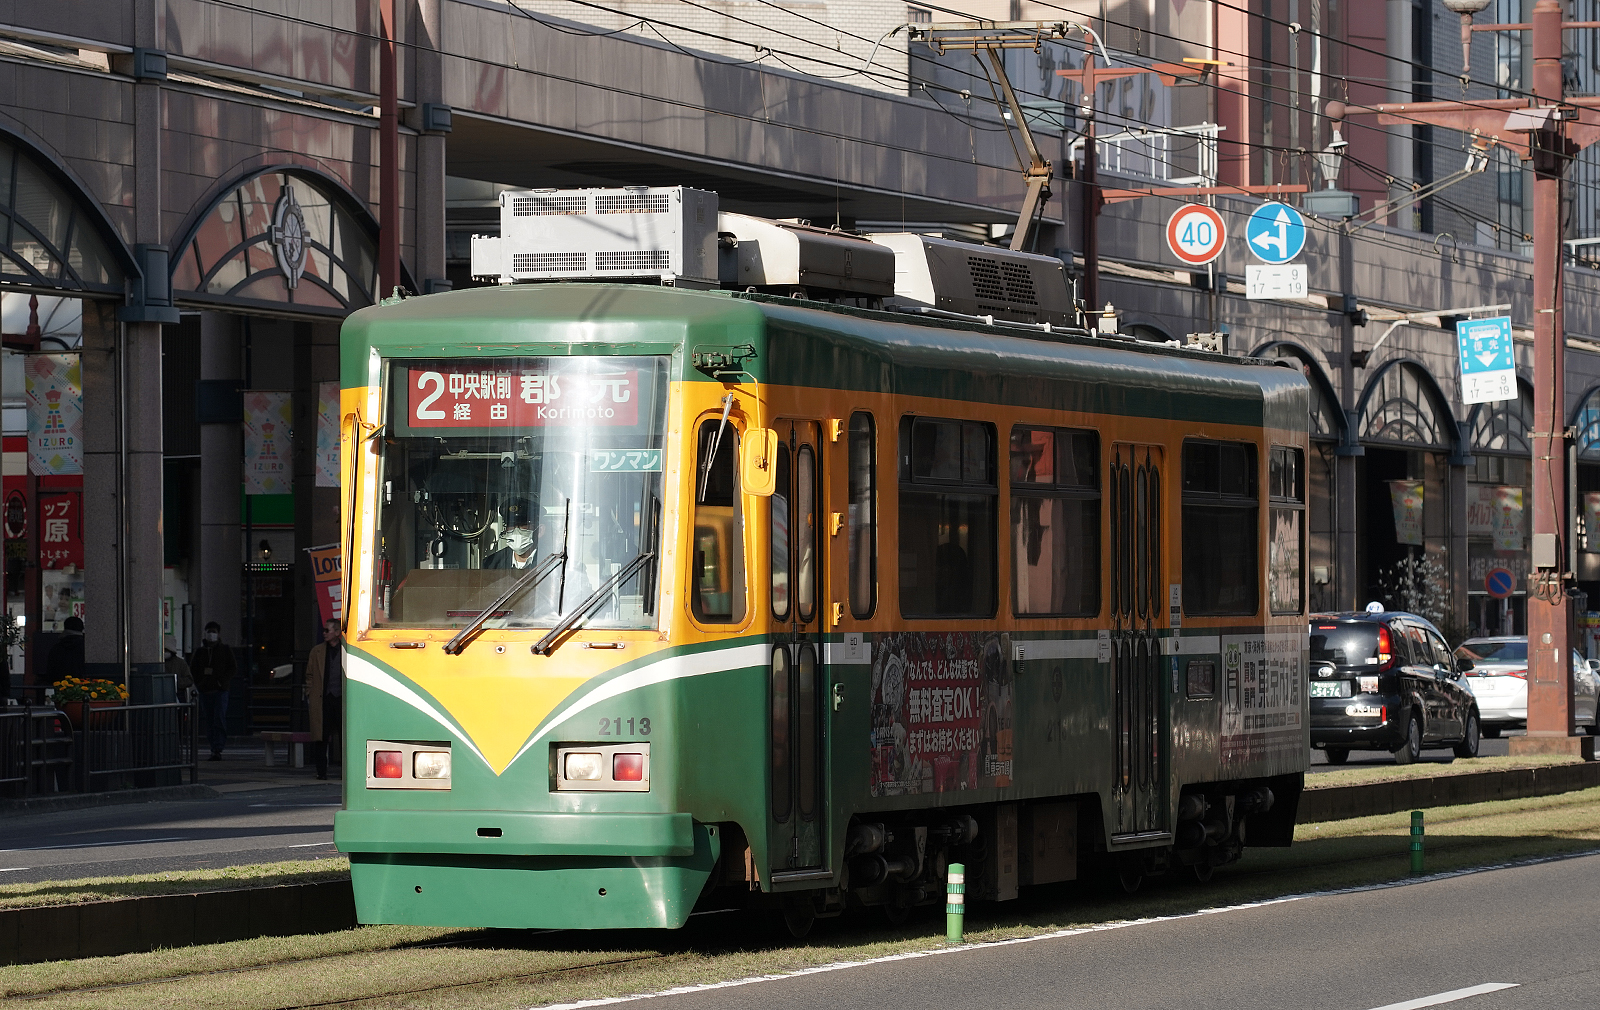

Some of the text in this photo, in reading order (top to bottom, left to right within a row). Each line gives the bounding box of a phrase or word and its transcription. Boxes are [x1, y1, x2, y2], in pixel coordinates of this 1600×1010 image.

[1182, 221, 1211, 246] 40
[1255, 269, 1262, 281] 7
[1291, 268, 1299, 281] 9
[1252, 283, 1265, 294] 17
[1288, 282, 1302, 294] 19
[1474, 339, 1499, 352] 優先
[449, 370, 511, 400] 中央駅前
[1472, 378, 1477, 388] 7
[1500, 375, 1507, 385] 9
[416, 371, 446, 420] 2
[1470, 388, 1480, 399] 17
[1499, 385, 1510, 395] 19
[453, 402, 508, 421] 経由
[537, 405, 615, 420] Korimoto
[38, 437, 74, 447] IZURO
[594, 451, 658, 469] ワンマン
[44, 518, 70, 543] 原
[313, 556, 341, 576] LOT
[909, 659, 979, 681] なんでも、どんな状態でも
[599, 717, 652, 736] 2113
[909, 727, 980, 754] まずはお持ちください
